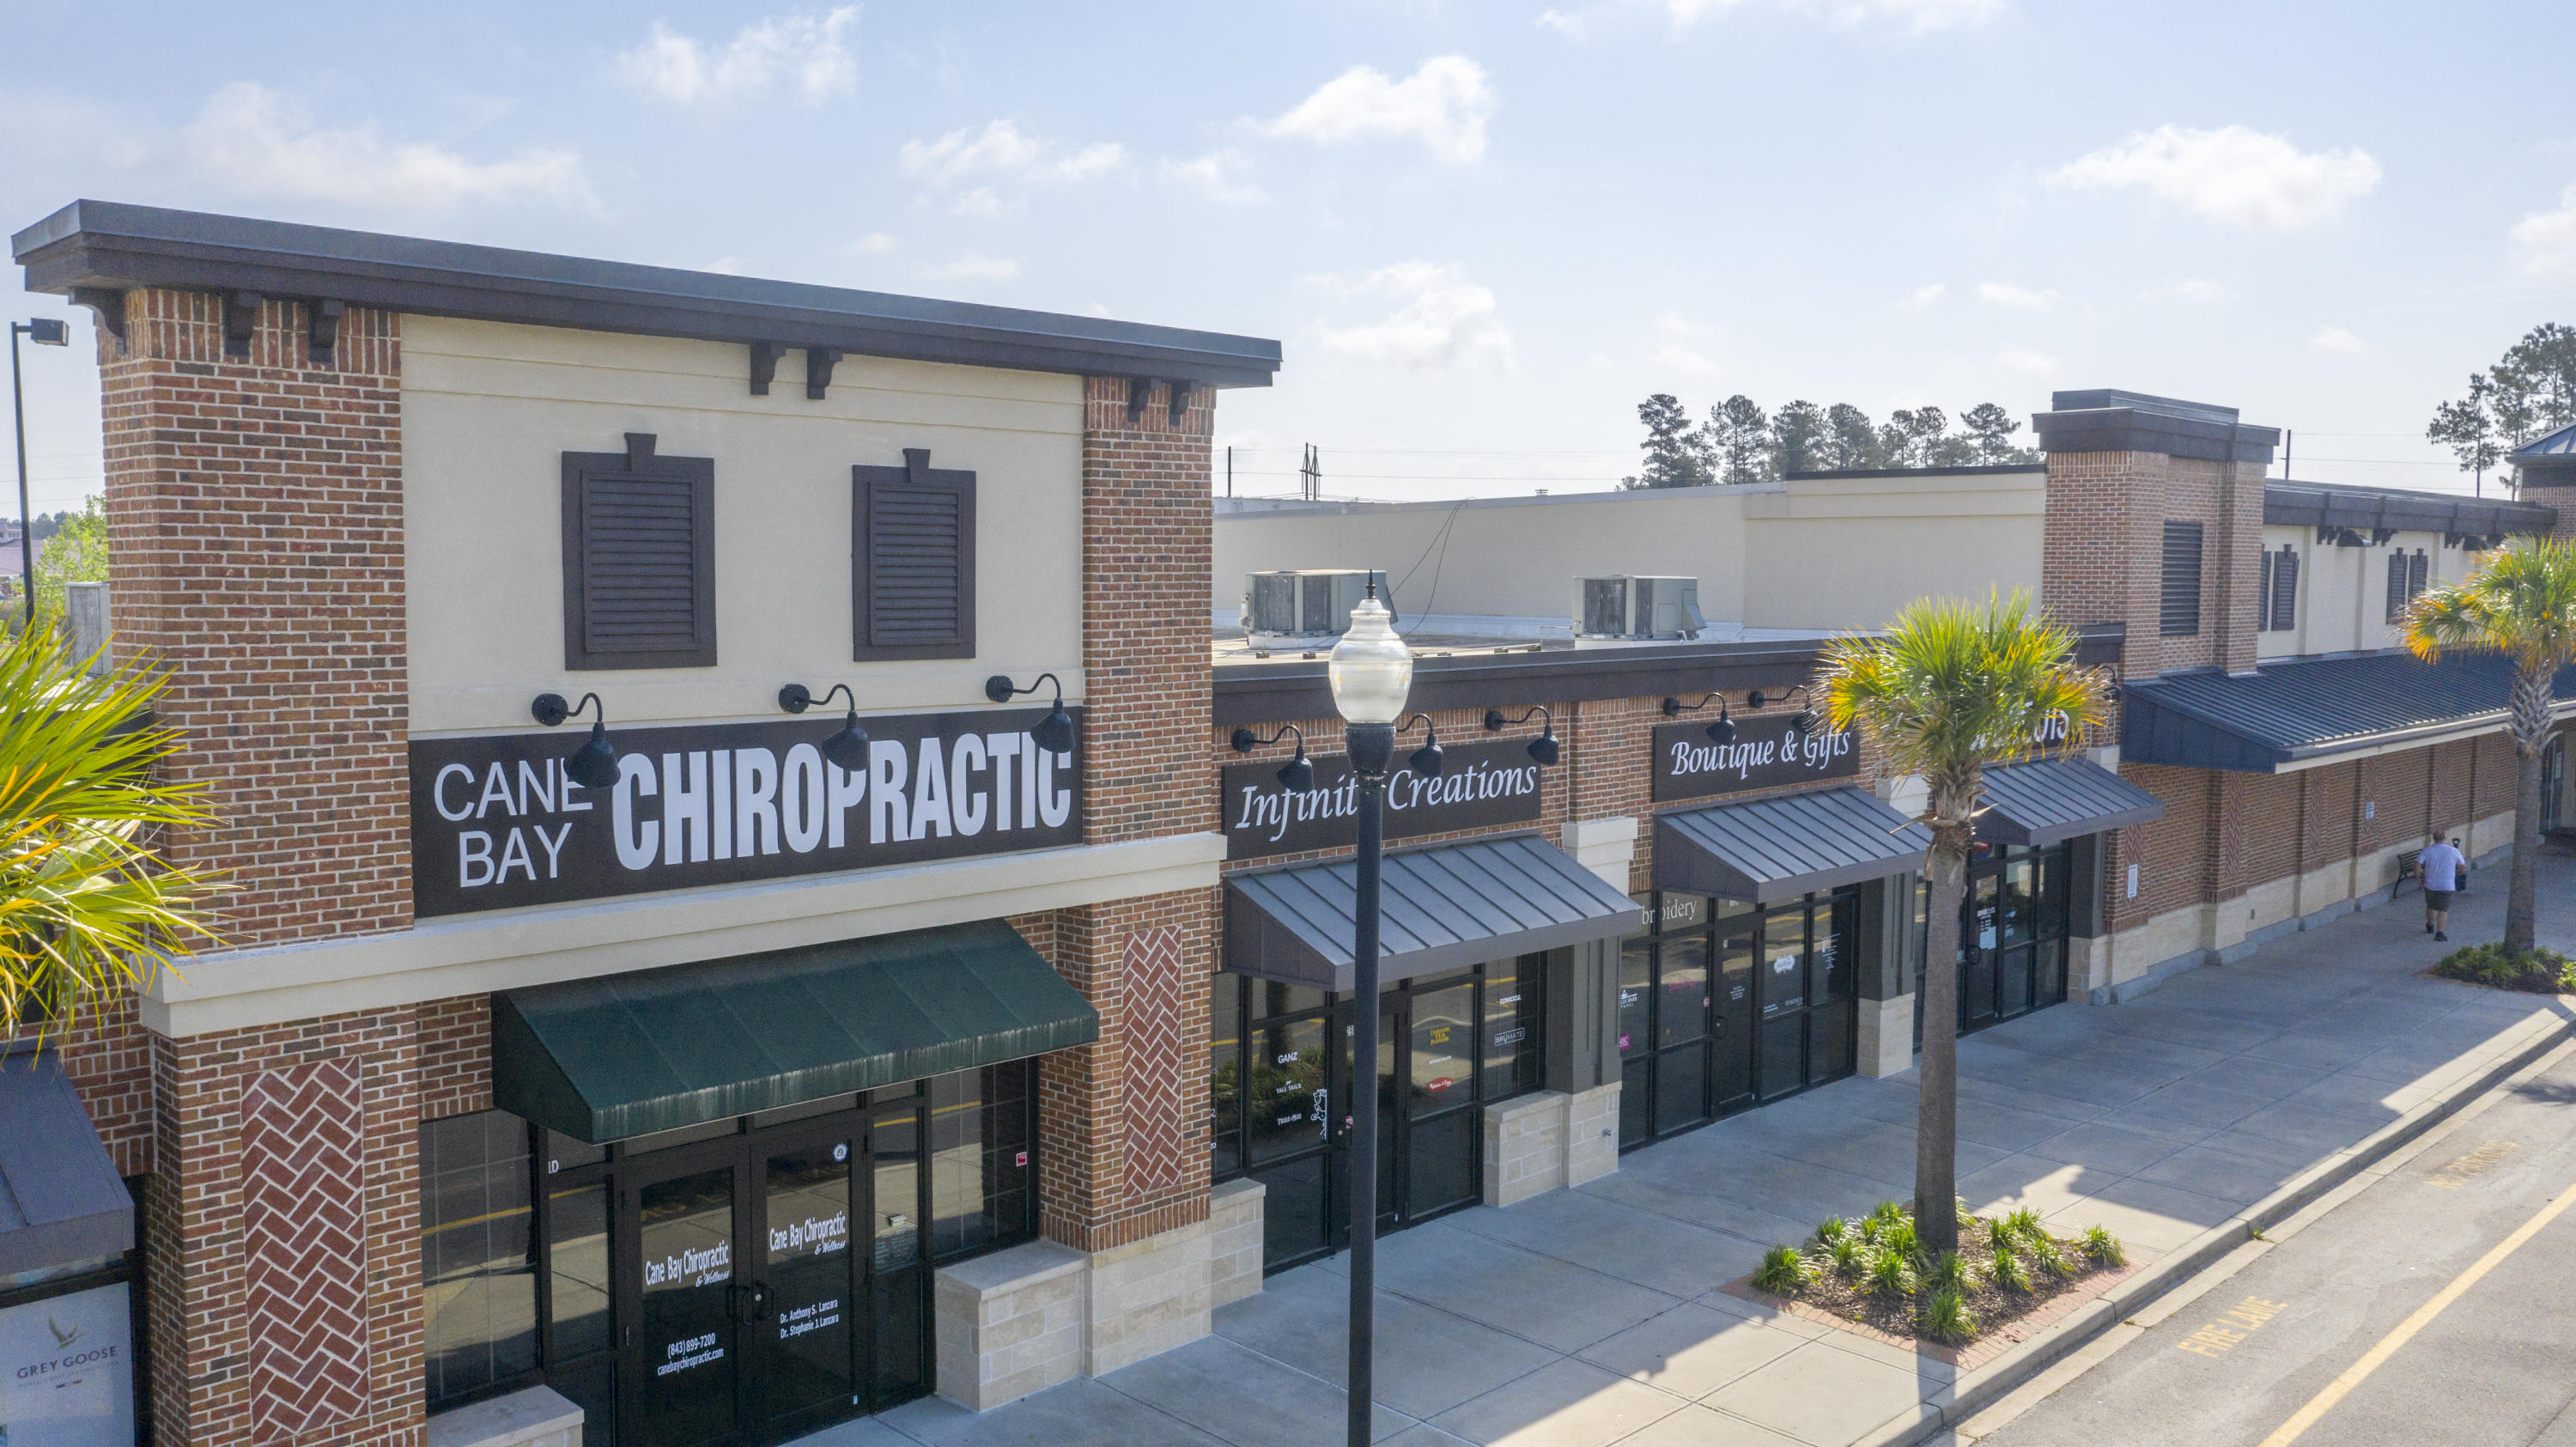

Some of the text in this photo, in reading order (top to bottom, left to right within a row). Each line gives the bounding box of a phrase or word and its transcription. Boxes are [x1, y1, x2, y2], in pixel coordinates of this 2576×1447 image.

[1670, 721, 1850, 781] Boutique & Gifts
[434, 757, 593, 822] CANE
[612, 732, 1072, 871] CHIROPRACTIC
[1235, 759, 1537, 842] Infinit Creations
[459, 823, 573, 888] BAY
[1278, 1051, 1298, 1064] GANZ
[1288, 1083, 1303, 1091] TAILS
[769, 1210, 846, 1252] Cane Bay Chiropractic
[814, 1240, 846, 1255] & Wellness
[645, 1239, 729, 1286] Cane Bay Chiropractic
[695, 1270, 730, 1287] & Wellness
[780, 1313, 789, 1324] Dr.
[789, 1306, 811, 1322] Anthony
[811, 1304, 817, 1316] S.
[780, 1328, 789, 1340] Dr.
[789, 1319, 814, 1337] Stephanie
[2177, 1295, 2288, 1358] FIRE LANE
[657, 1347, 724, 1377] canebaychiropractic.com
[667, 1332, 717, 1359] (843) 899-7200
[16, 1359, 58, 1379] GREY
[62, 1346, 118, 1367] GOOSE
